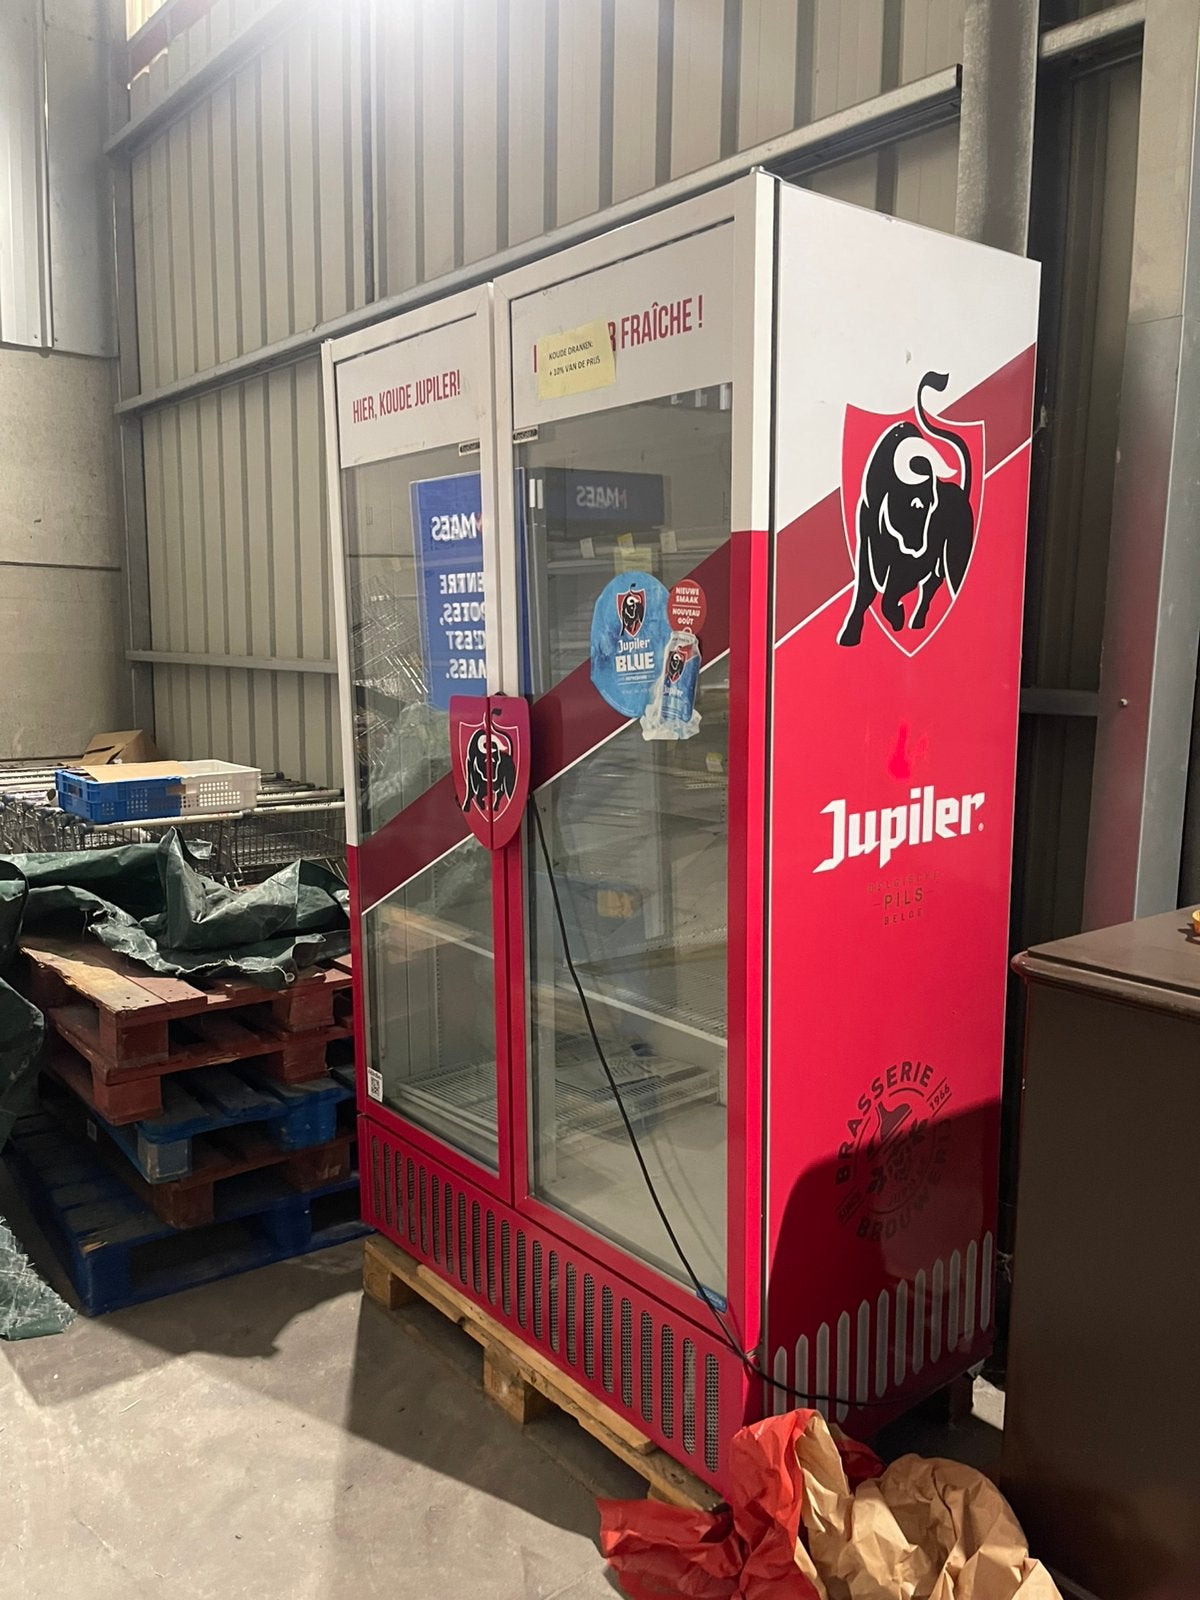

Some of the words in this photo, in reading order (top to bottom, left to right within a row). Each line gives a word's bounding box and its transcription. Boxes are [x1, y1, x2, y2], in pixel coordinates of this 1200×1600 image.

[620, 297, 693, 350] FRAÎCHE
[548, 348, 567, 361] KOUDE
[564, 362, 578, 373] VAN
[577, 360, 586, 369] DE
[352, 395, 378, 424] HIER,
[379, 383, 413, 416] KOUDE
[414, 368, 461, 407] JUPILER!
[675, 586, 700, 597] NIEUWE
[675, 595, 699, 604] SMAAK
[672, 607, 701, 617] NOUVEAU
[677, 615, 694, 626] GOÛT
[617, 637, 651, 654] Jupiler
[614, 651, 656, 673] BLUE
[883, 887, 924, 910] PILS
[928, 1082, 951, 1111] 1966
[835, 1060, 935, 1185] BRASSERIE
